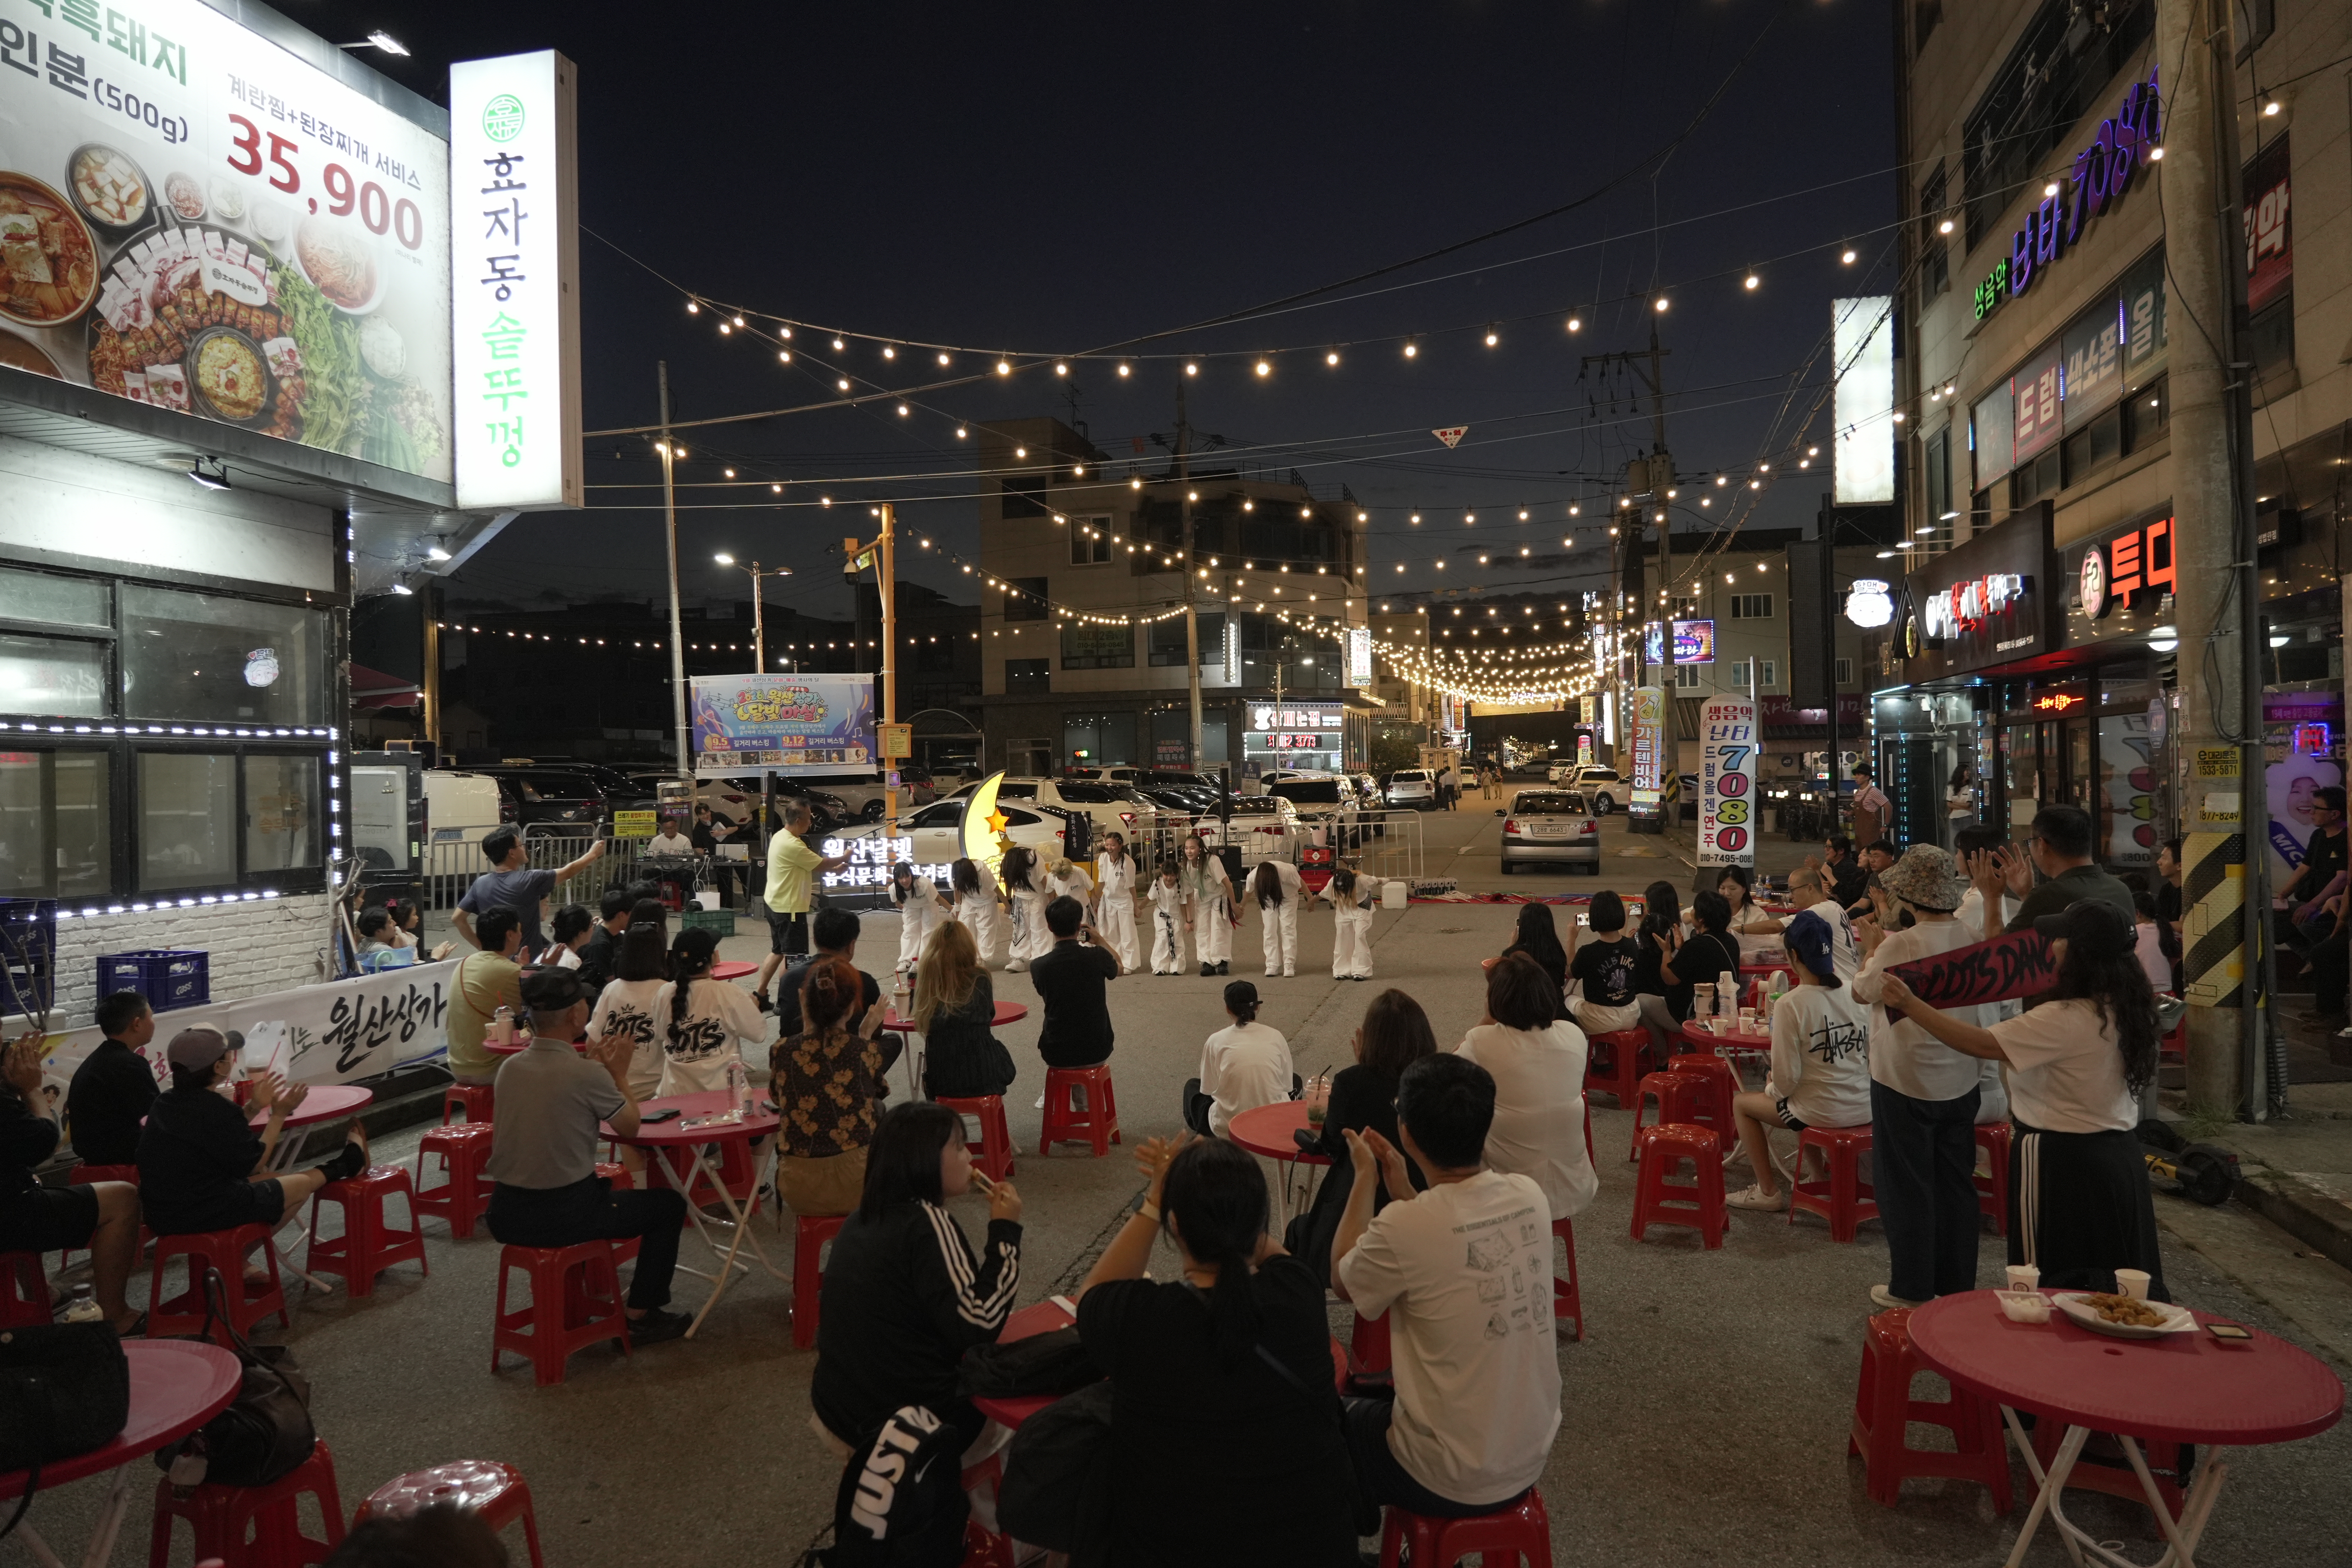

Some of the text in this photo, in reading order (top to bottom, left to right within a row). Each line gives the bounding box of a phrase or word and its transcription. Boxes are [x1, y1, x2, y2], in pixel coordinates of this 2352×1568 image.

[228, 72, 421, 191] 계란찜+된장찌개 서비스
[227, 113, 423, 251] 35,900
[480, 152, 529, 302] 효자동
[2012, 180, 2062, 299] 난타
[1975, 258, 2006, 320] 생음악
[481, 310, 529, 468] 솥뚜껑
[2019, 366, 2056, 438] 드럼
[2257, 529, 2277, 545] 성법원점
[1855, 581, 1877, 592] 할맥
[738, 690, 764, 704] 2026
[768, 689, 820, 705] 월산상가
[747, 703, 817, 722] 달빛 마실
[1707, 705, 1753, 721] 생음악
[713, 737, 728, 746] 9.5
[782, 736, 805, 744] 9.12
[1295, 735, 1315, 747] 3773
[1710, 725, 1750, 741] 난타
[1634, 727, 1652, 789] 가르텐비어
[2198, 765, 2237, 775] 1533-5871
[1716, 745, 1751, 851] 7080
[1629, 804, 1648, 814] Garten
[822, 837, 913, 864] 월산달빛
[1072, 837, 1077, 848] 홍성
[1700, 854, 1753, 864] 010-7495-0082
[1821, 943, 1830, 954] LA
[1597, 957, 1618, 975] MLB
[322, 982, 448, 1073] 월산상가
[1452, 1223, 1466, 1234] THE
[1510, 1206, 1535, 1219] CAMPING
[850, 1418, 920, 1540] JUST
